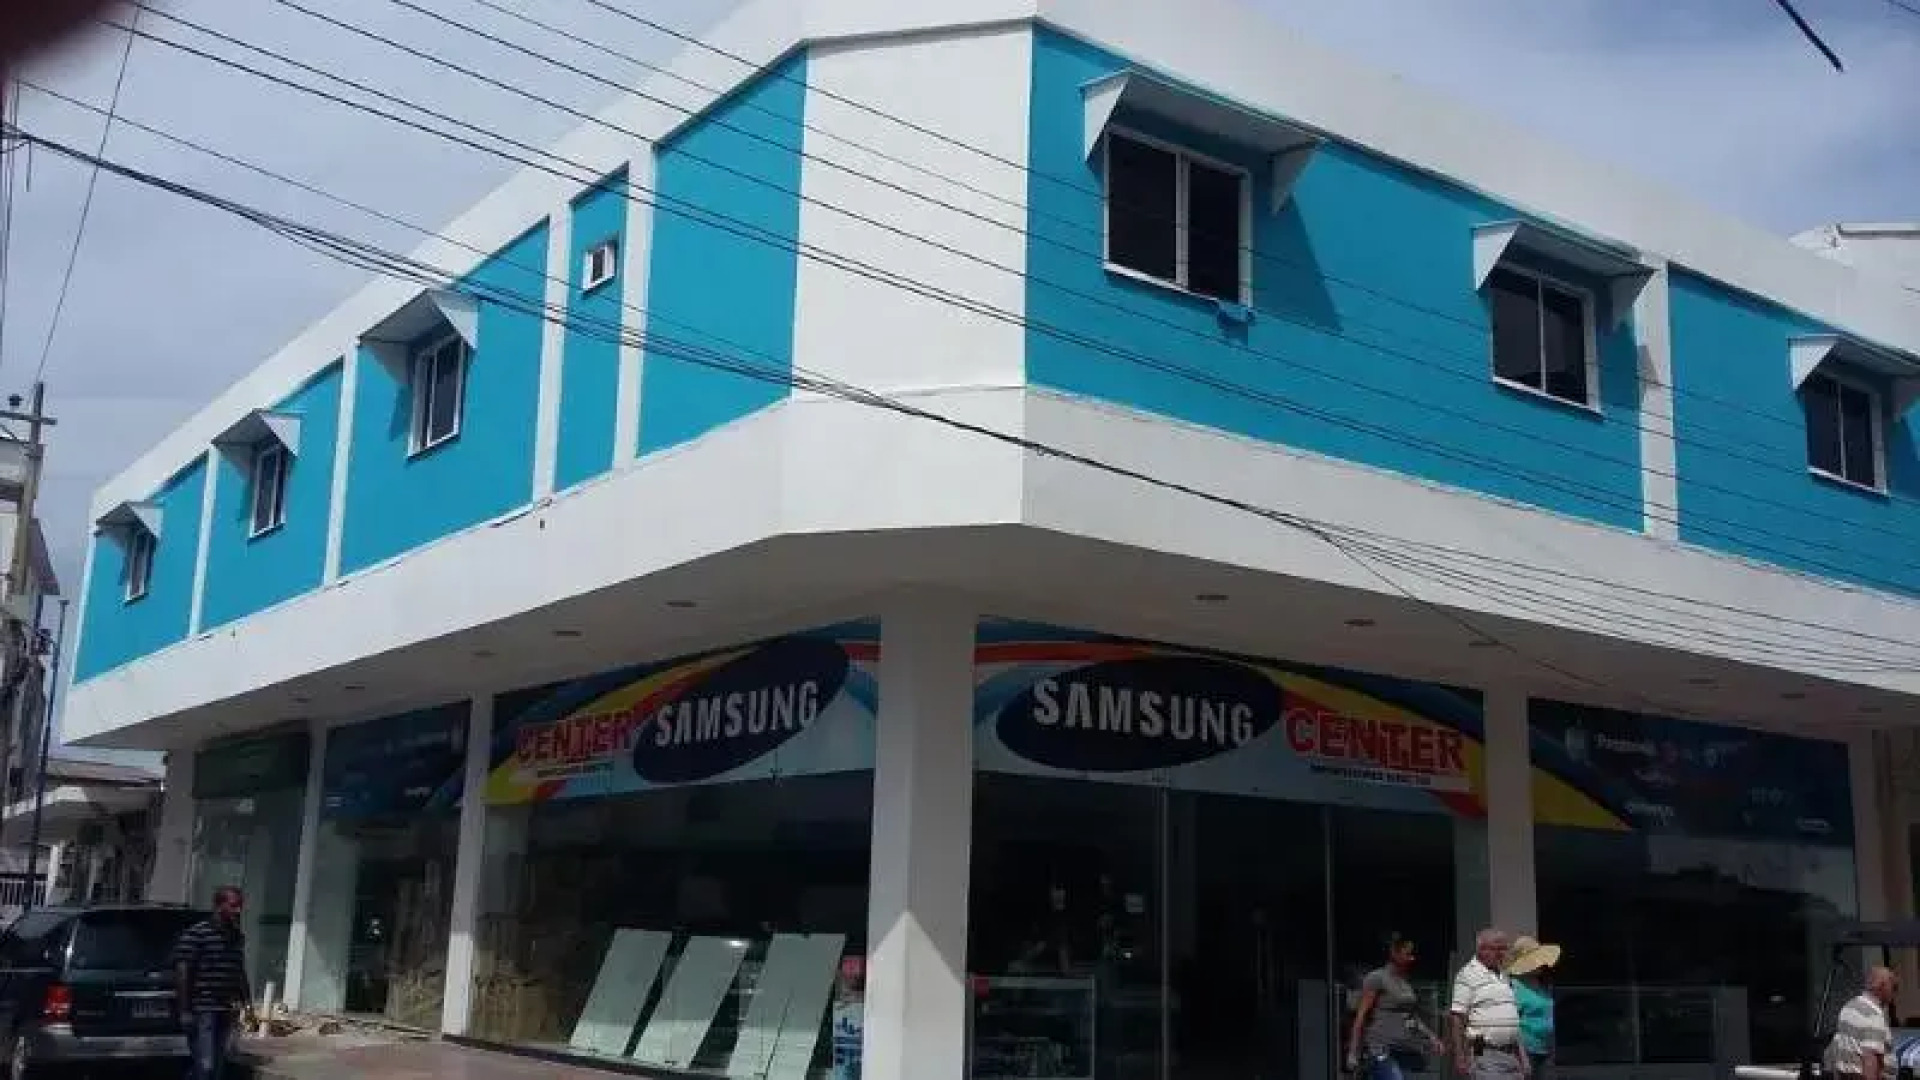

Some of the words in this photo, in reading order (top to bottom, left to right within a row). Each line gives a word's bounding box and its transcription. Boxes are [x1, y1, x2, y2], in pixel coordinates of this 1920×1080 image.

[515, 709, 633, 764] CENTER
[654, 680, 819, 748] SAMSUNG
[1032, 676, 1255, 748] SAMSUNG
[1283, 707, 1465, 772] CENTER
